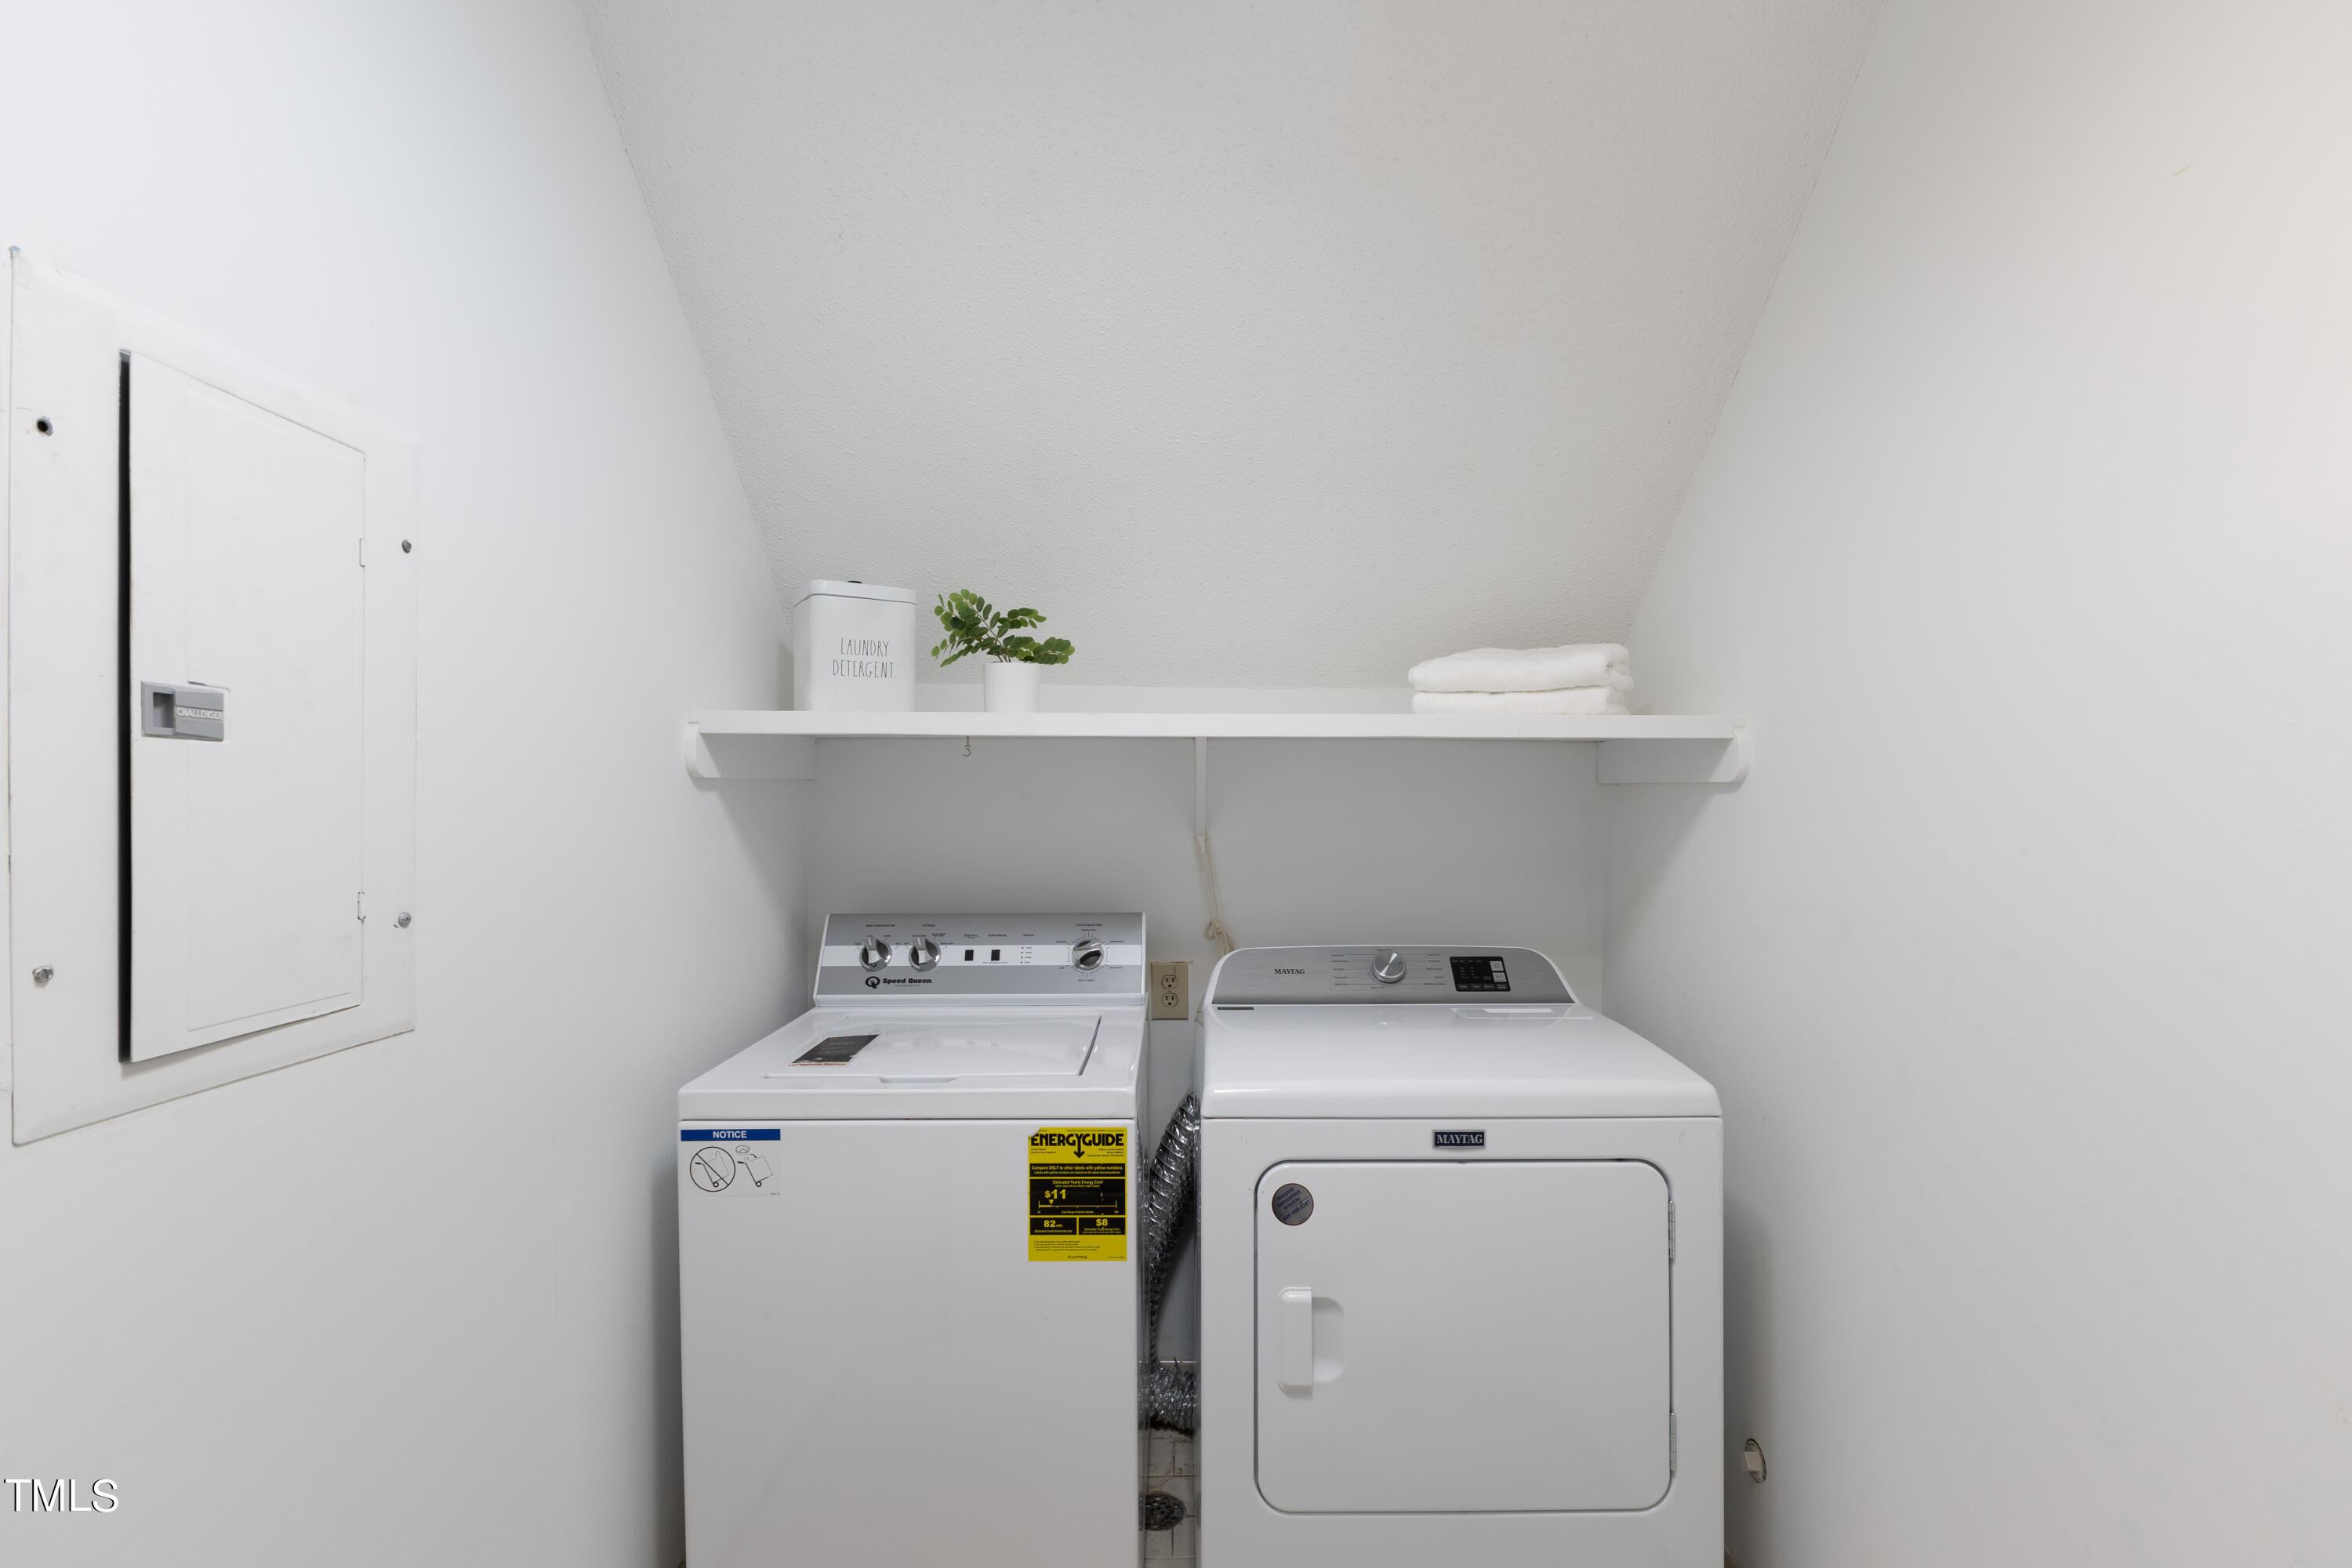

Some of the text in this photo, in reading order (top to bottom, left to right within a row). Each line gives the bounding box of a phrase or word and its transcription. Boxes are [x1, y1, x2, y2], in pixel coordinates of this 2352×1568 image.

[840, 637, 889, 657] LAUNDRY
[176, 707, 223, 720] CHALLENGER
[1031, 1133, 1124, 1146] ENERGYGUIDE
[1436, 1134, 1483, 1144] MAYTAG
[1044, 1189, 1066, 1199] $11
[1095, 1218, 1108, 1227] $8
